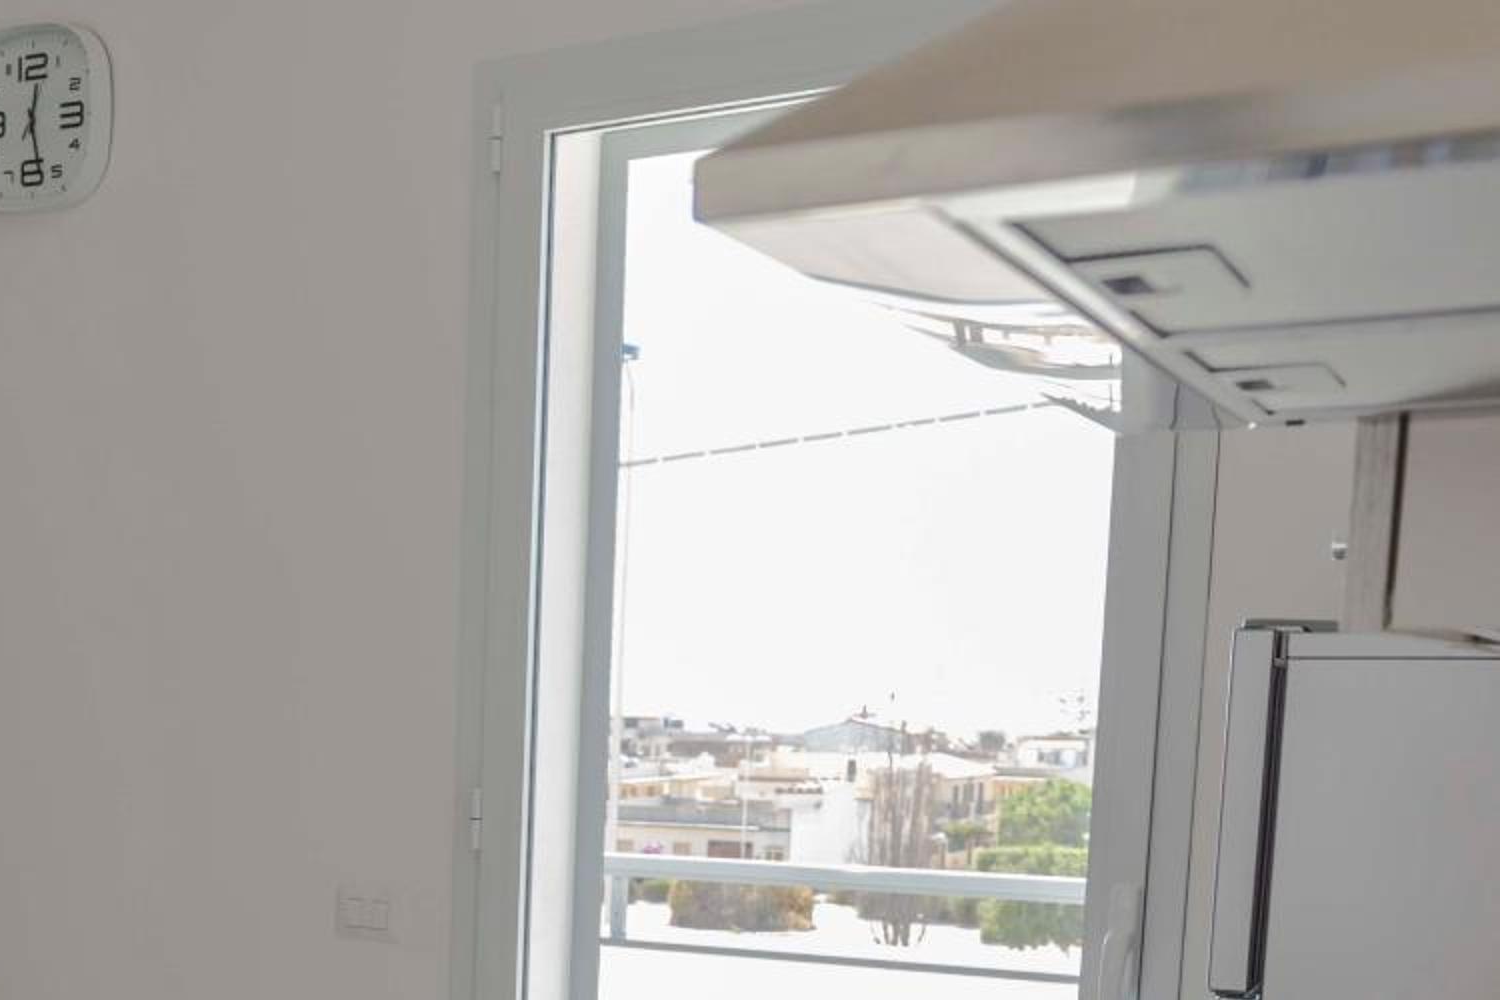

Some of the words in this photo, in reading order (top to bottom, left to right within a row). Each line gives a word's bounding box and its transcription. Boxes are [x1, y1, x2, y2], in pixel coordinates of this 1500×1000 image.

[17, 52, 49, 82] 12
[69, 77, 81, 91] 2
[59, 100, 85, 129] 3
[68, 138, 80, 150] 4
[20, 157, 44, 187] 6
[51, 164, 63, 179] 5
